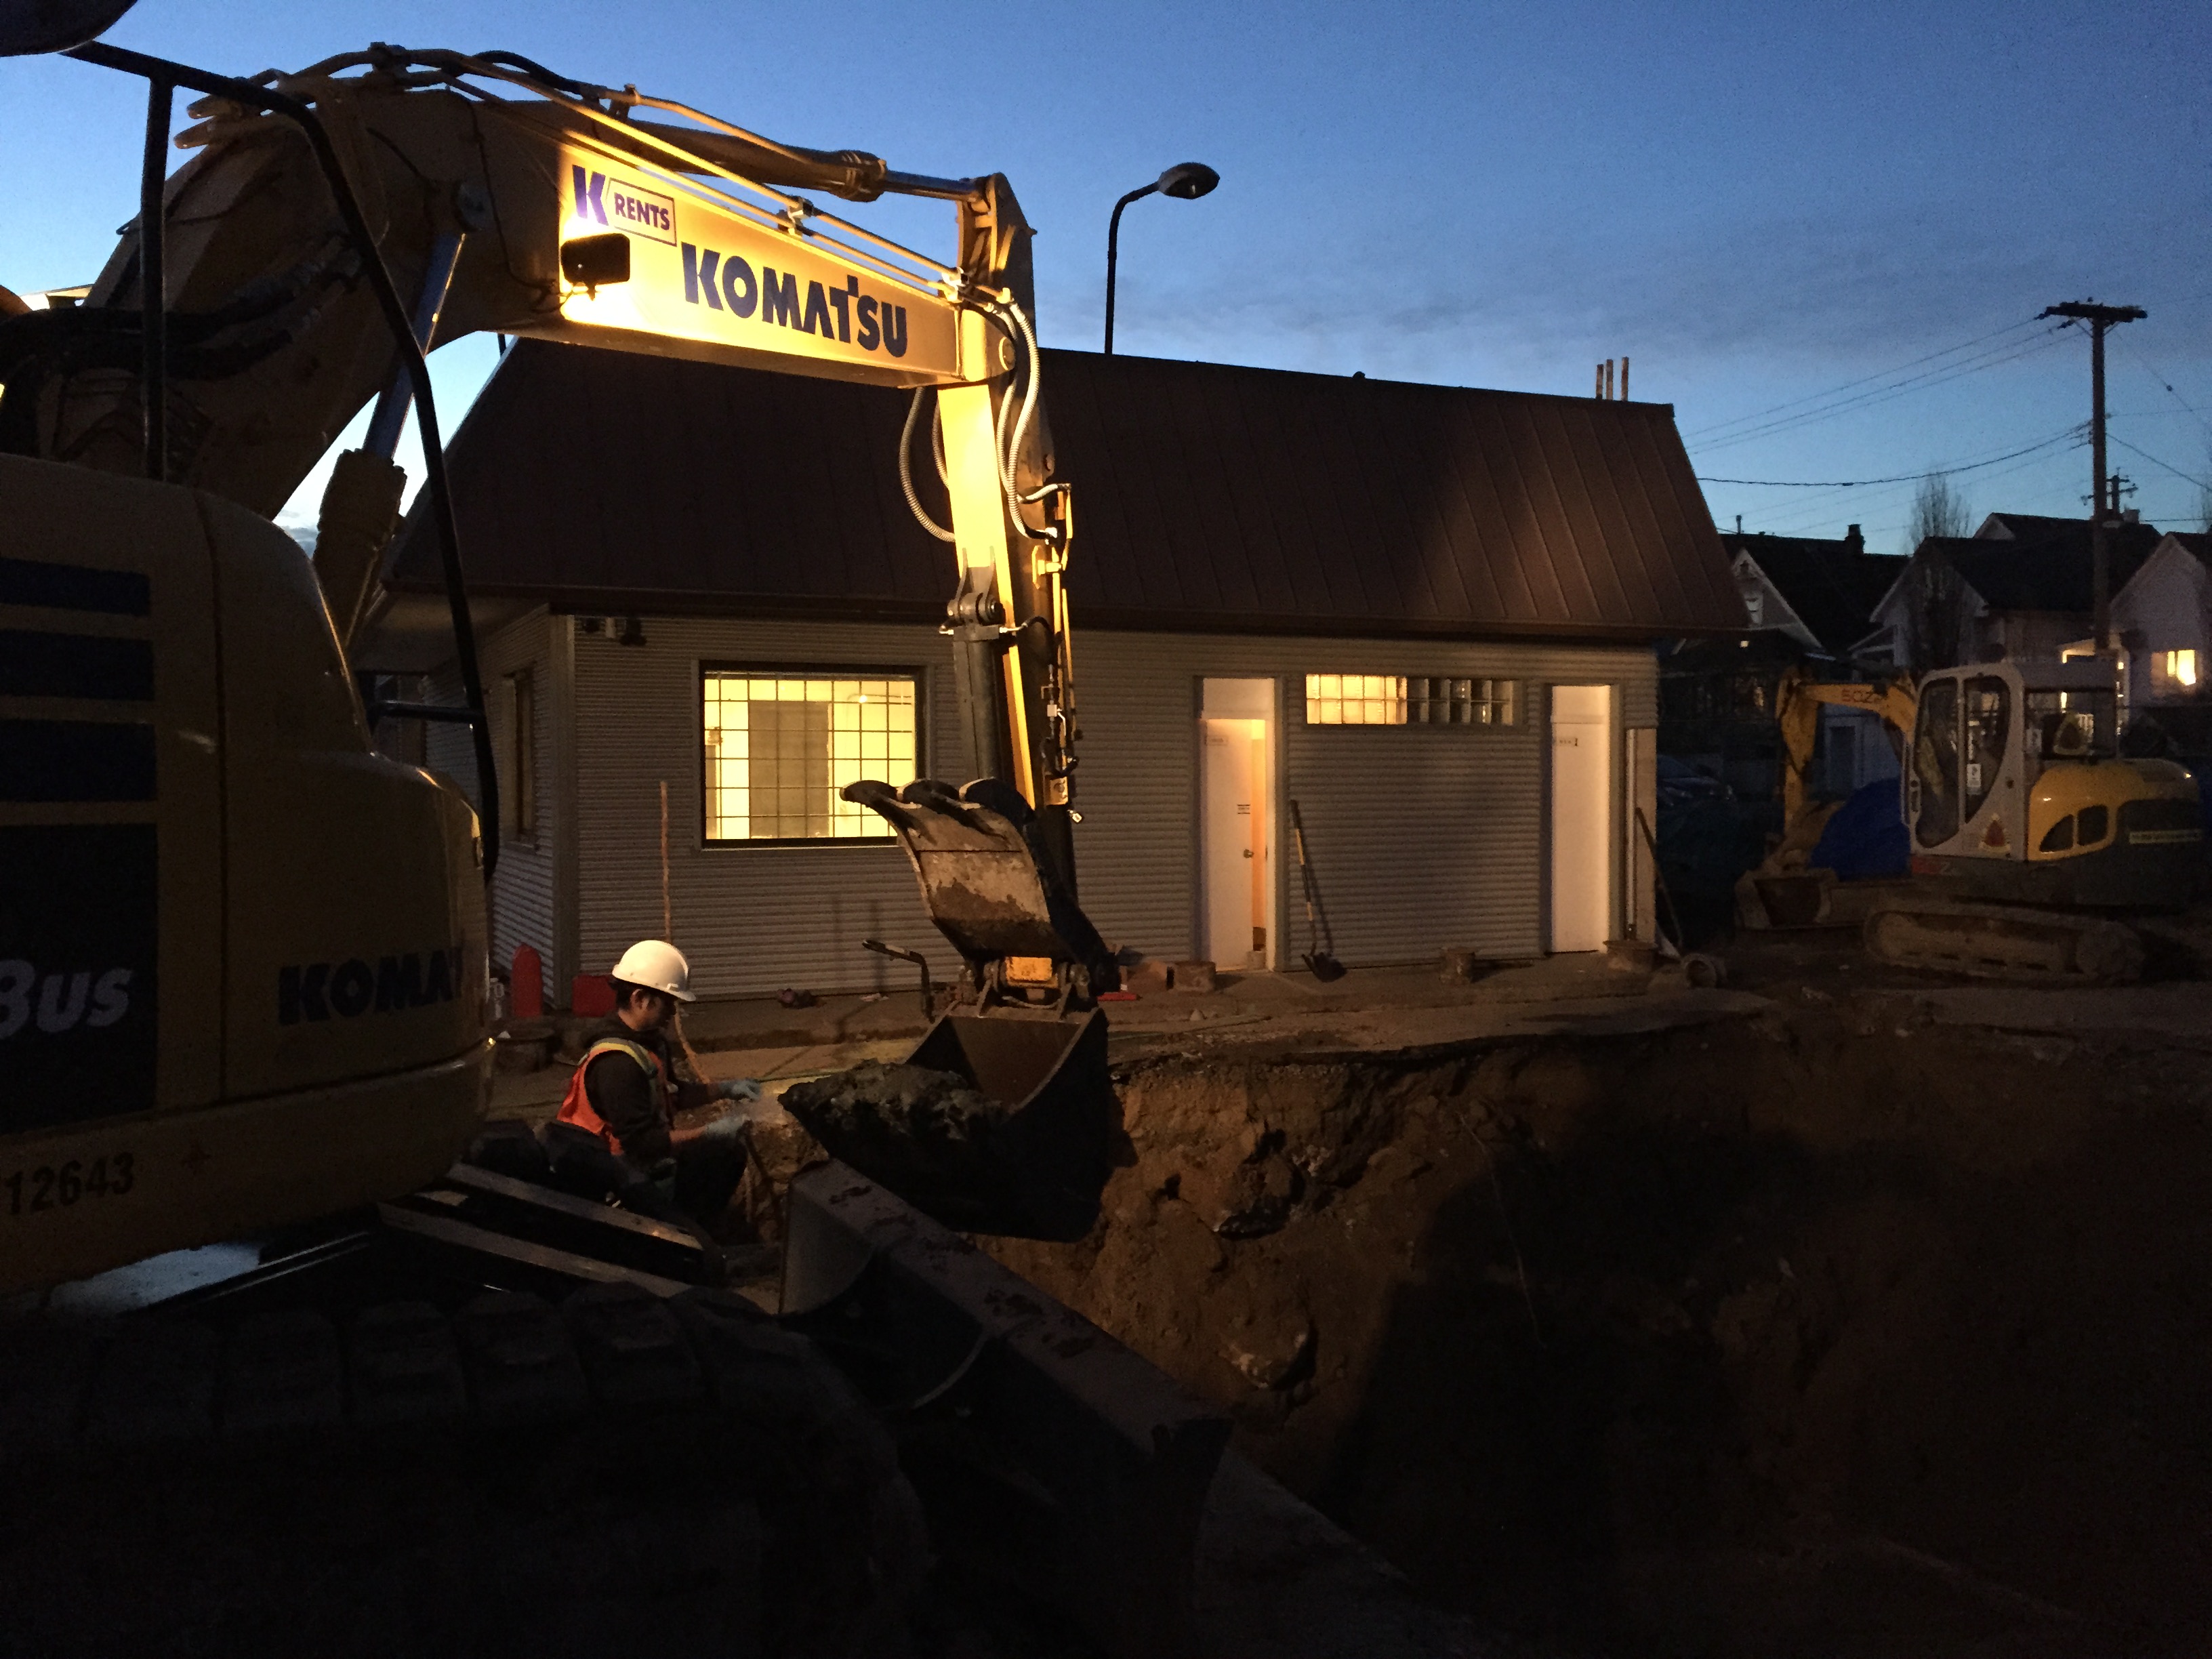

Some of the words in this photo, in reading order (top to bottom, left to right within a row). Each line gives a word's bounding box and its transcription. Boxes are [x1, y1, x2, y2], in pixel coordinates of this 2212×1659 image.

[573, 165, 608, 226] K
[615, 192, 670, 231] RENTS
[681, 242, 907, 358] KOMATSU
[6, 1152, 134, 1214] 12643
